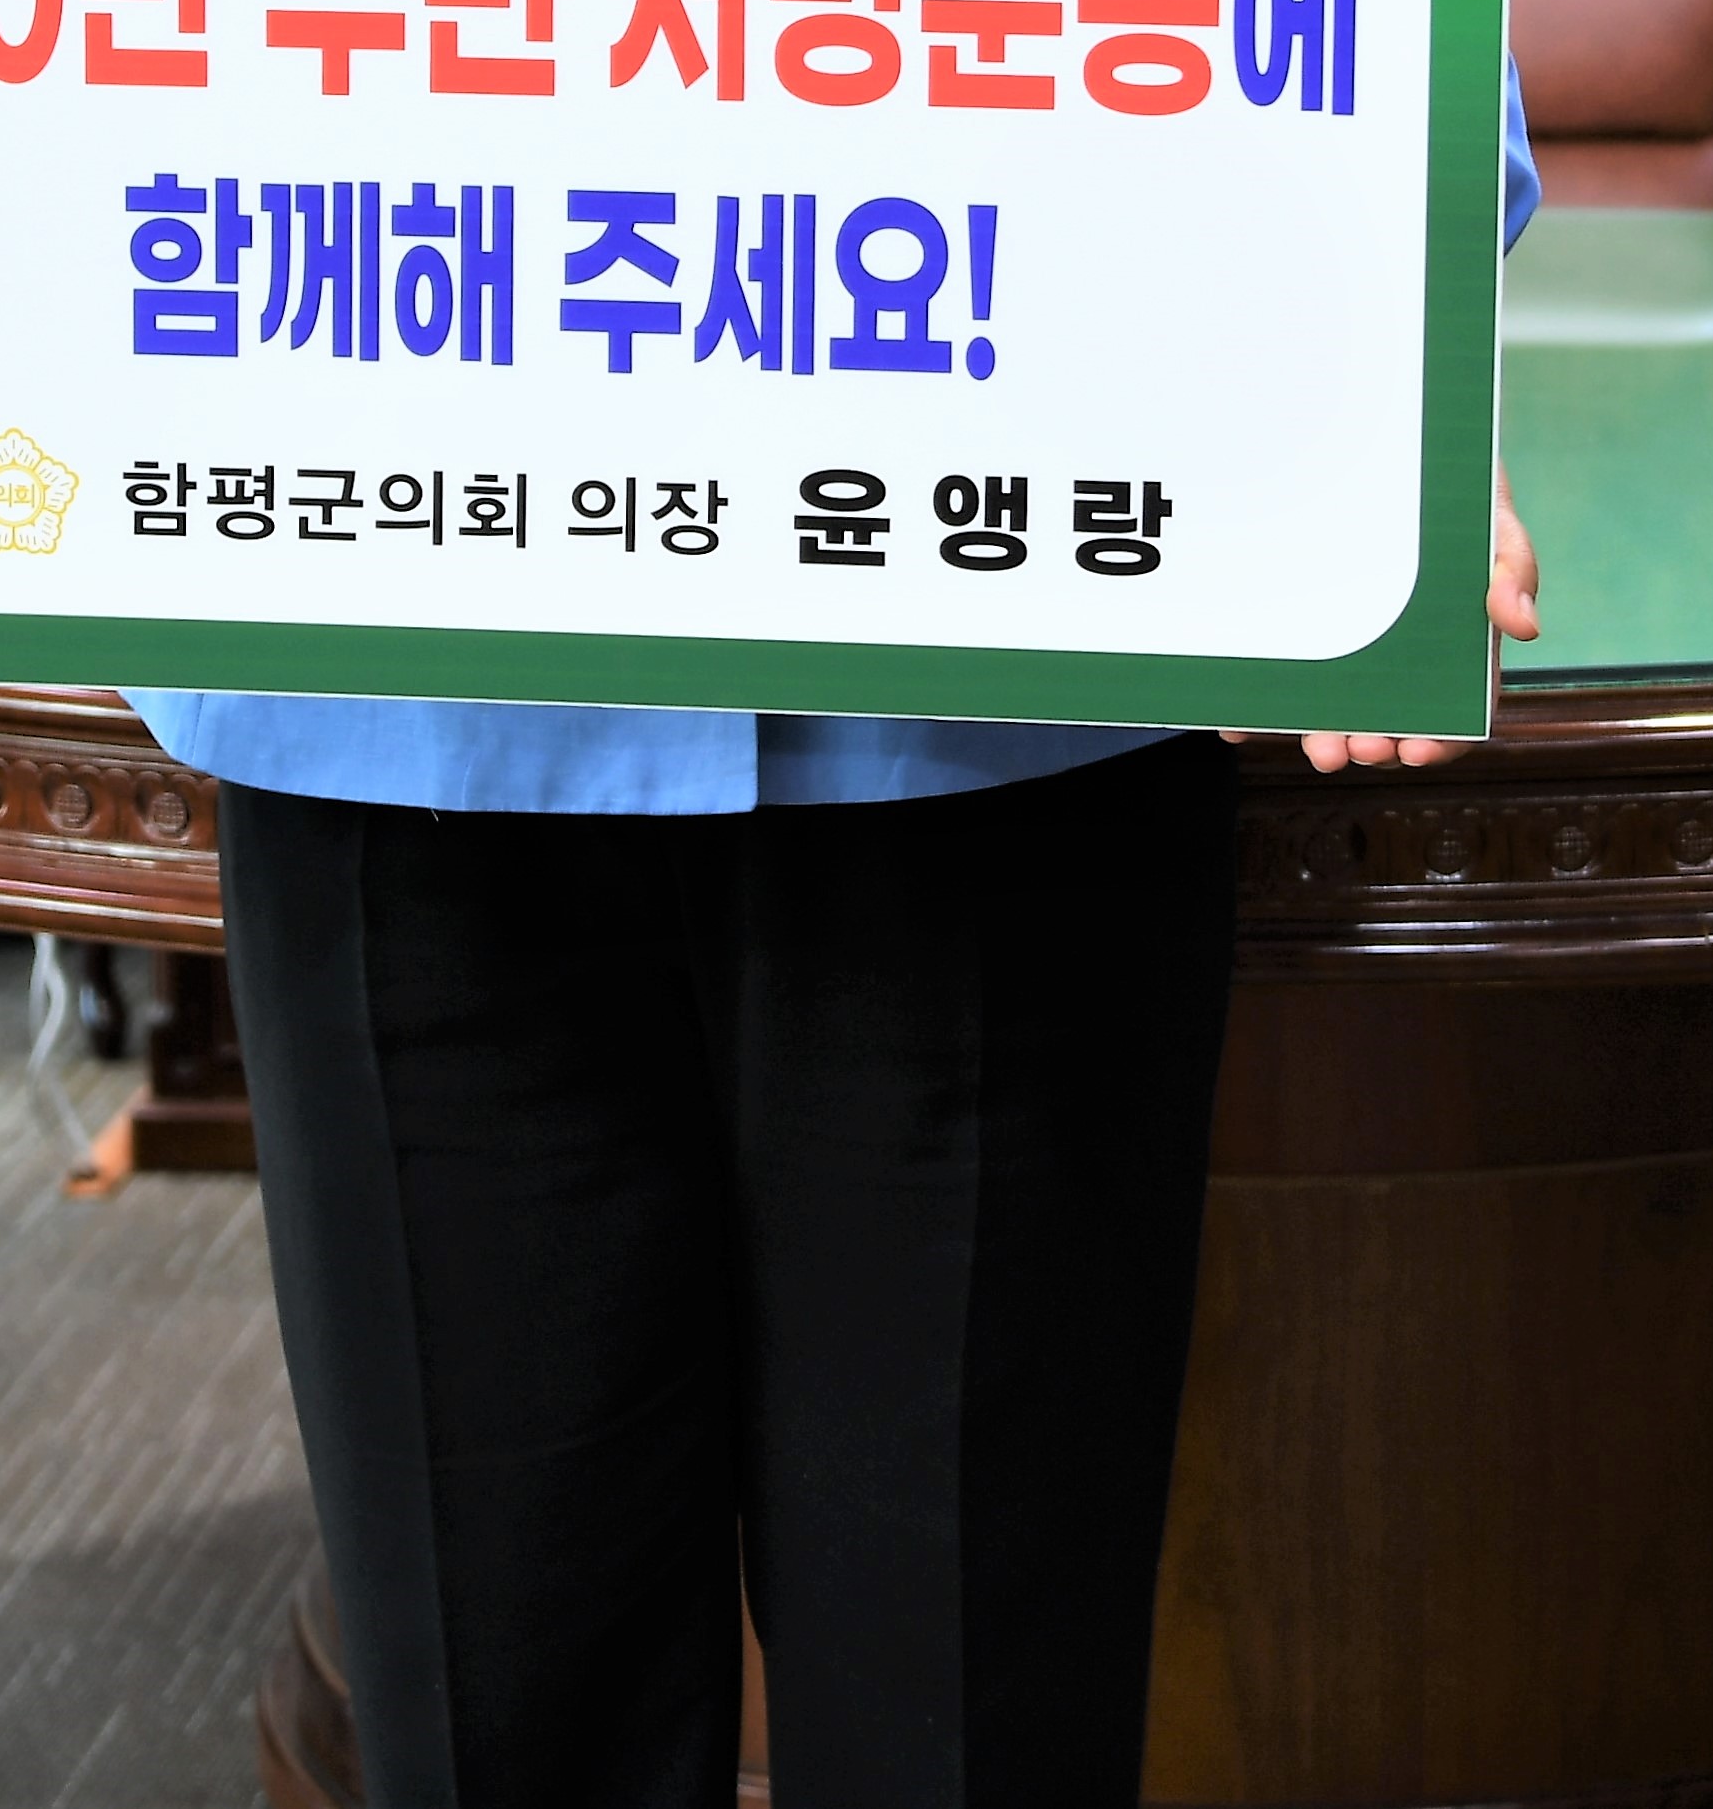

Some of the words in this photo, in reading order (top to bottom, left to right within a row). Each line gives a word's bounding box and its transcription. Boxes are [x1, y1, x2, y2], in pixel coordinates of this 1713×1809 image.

[125, 173, 514, 366] 함께해
[559, 189, 998, 381] 주세요!
[122, 461, 527, 549] 함평군의회
[567, 477, 729, 556] 의장
